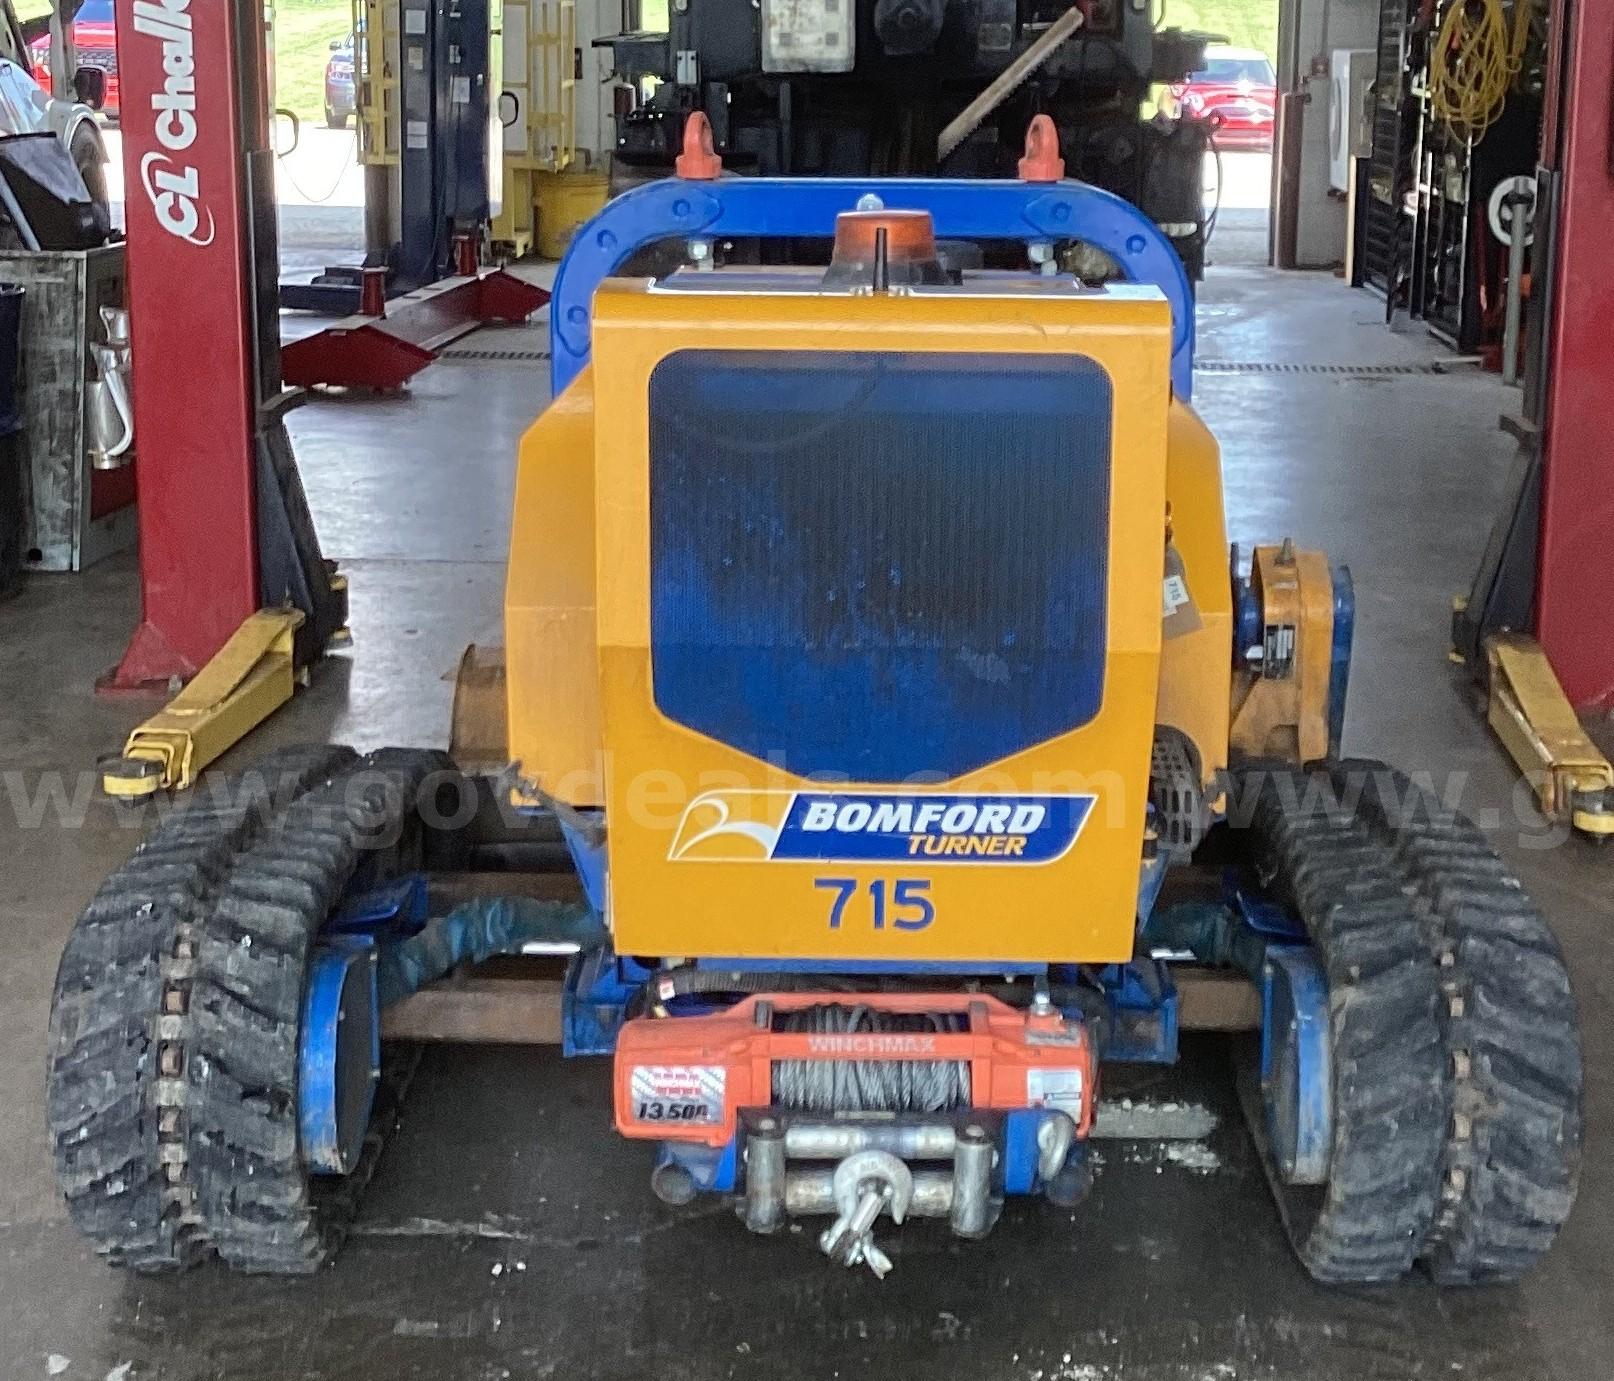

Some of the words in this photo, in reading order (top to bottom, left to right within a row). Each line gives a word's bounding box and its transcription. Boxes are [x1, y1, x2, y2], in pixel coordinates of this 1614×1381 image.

[155, 166, 199, 237] CL
[801, 803, 1046, 834] BOMFORD
[908, 835, 1027, 855] TURNER
[814, 878, 936, 930] 715
